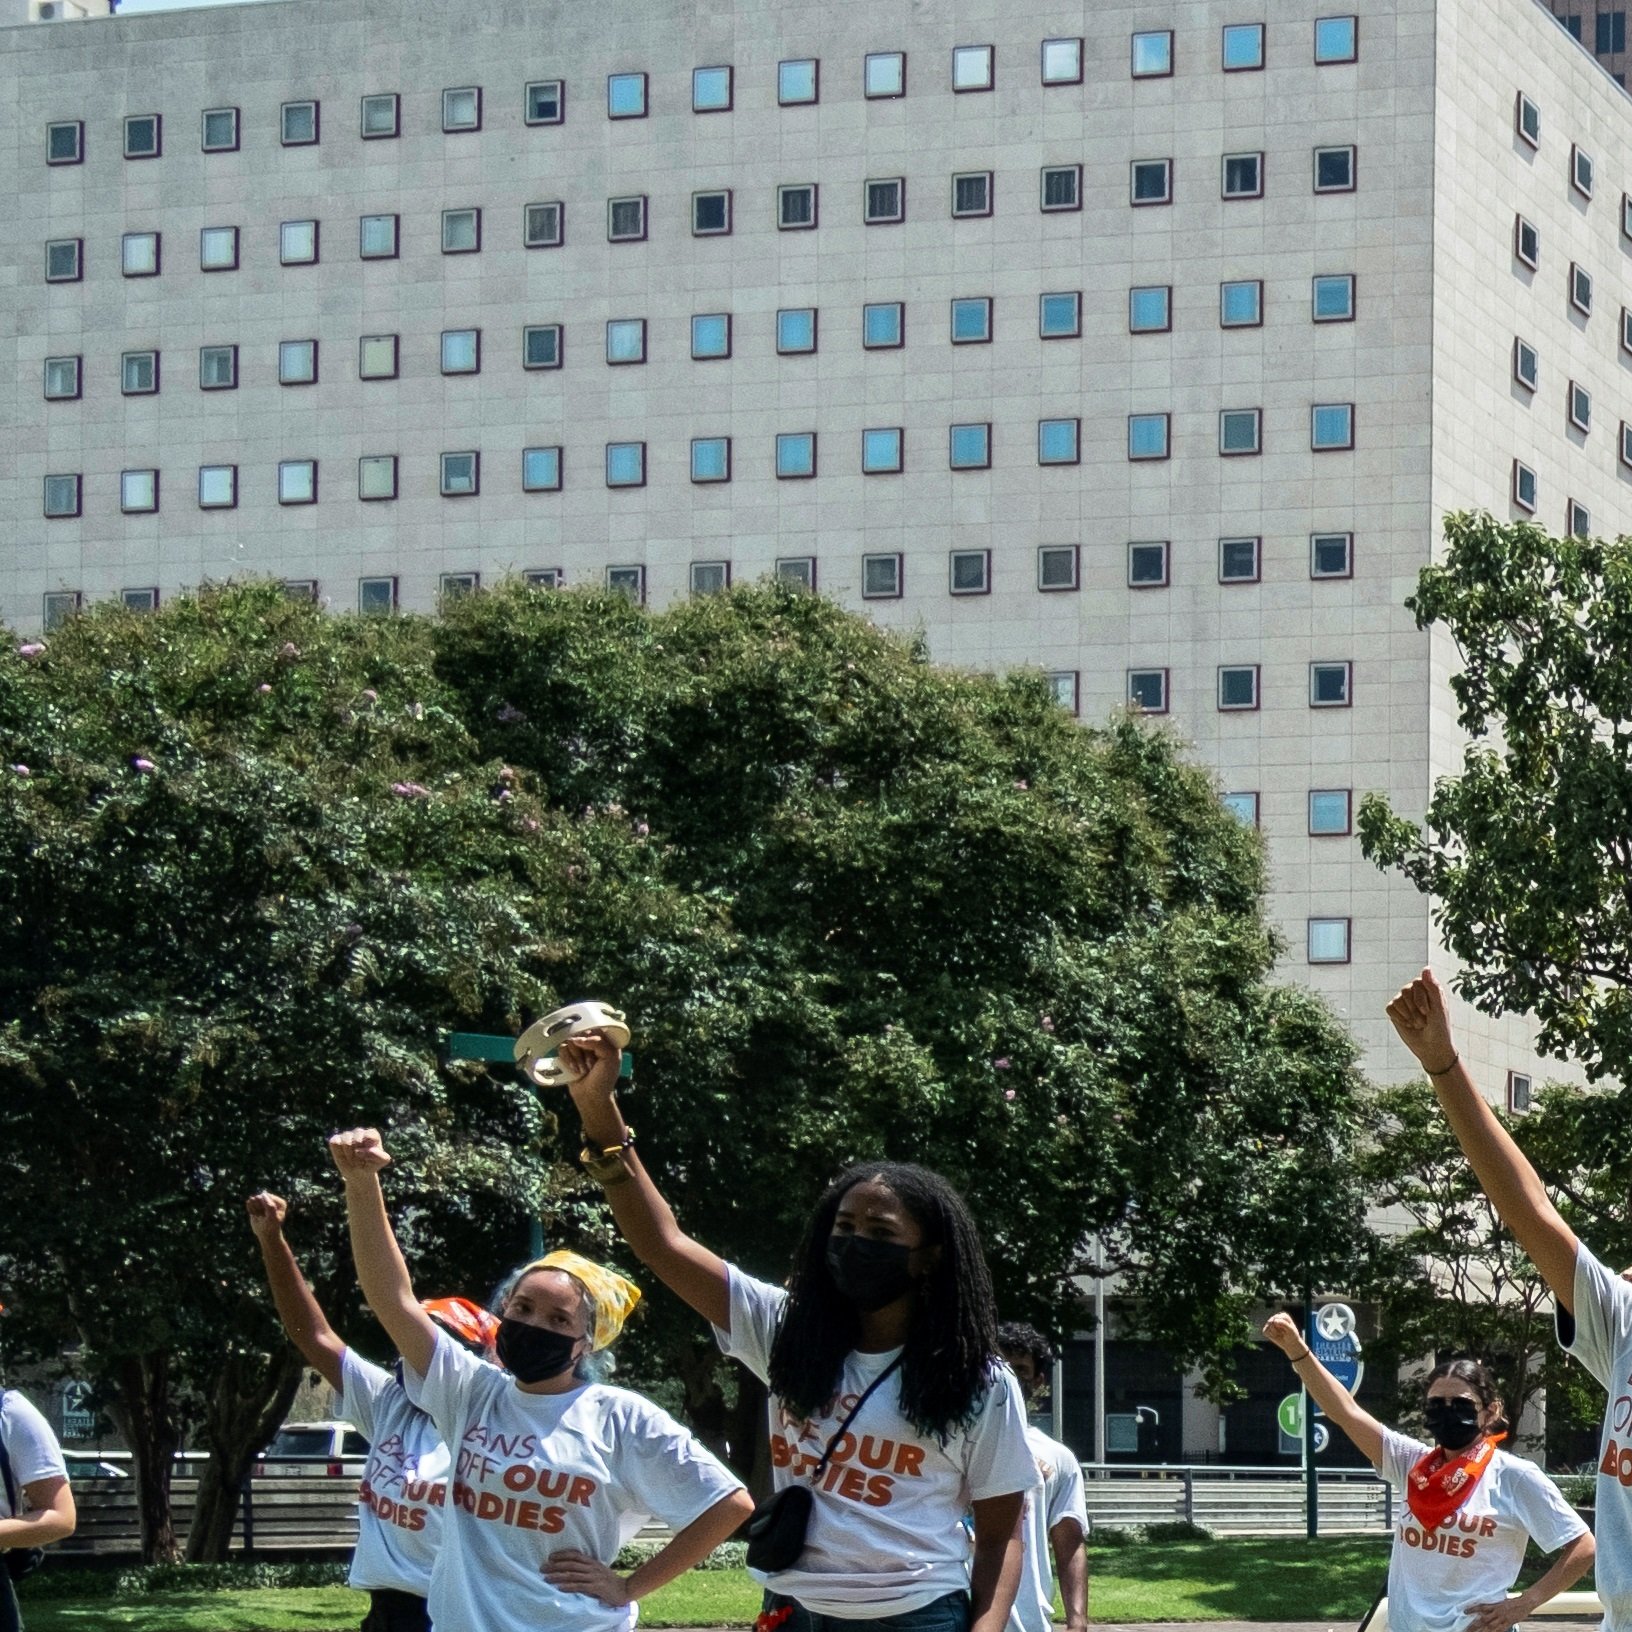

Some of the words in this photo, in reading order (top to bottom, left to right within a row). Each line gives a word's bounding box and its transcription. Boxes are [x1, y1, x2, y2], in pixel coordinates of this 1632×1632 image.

[1287, 1406, 1296, 1425] 1
[503, 1464, 597, 1508] OUR
[1399, 1526, 1479, 1559] ODIES
